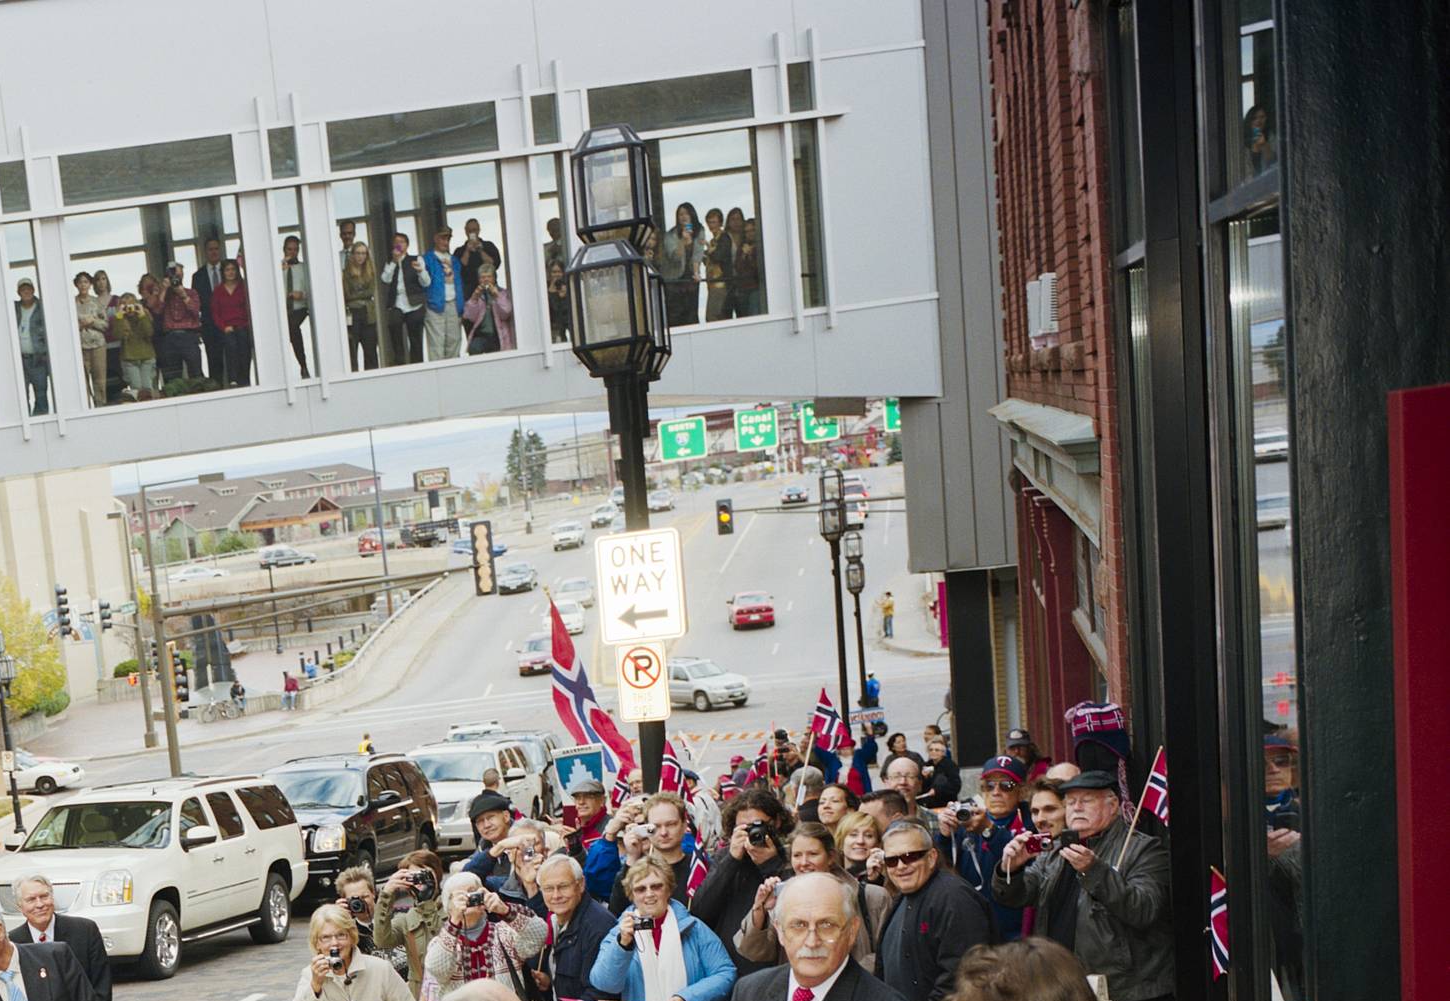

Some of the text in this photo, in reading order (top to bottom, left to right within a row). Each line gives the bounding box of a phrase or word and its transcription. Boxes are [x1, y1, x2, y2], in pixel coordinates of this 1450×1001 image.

[741, 412, 772, 424] Canal
[758, 424, 772, 433] Dr
[611, 541, 665, 568] ONE
[610, 569, 667, 596] WAY
